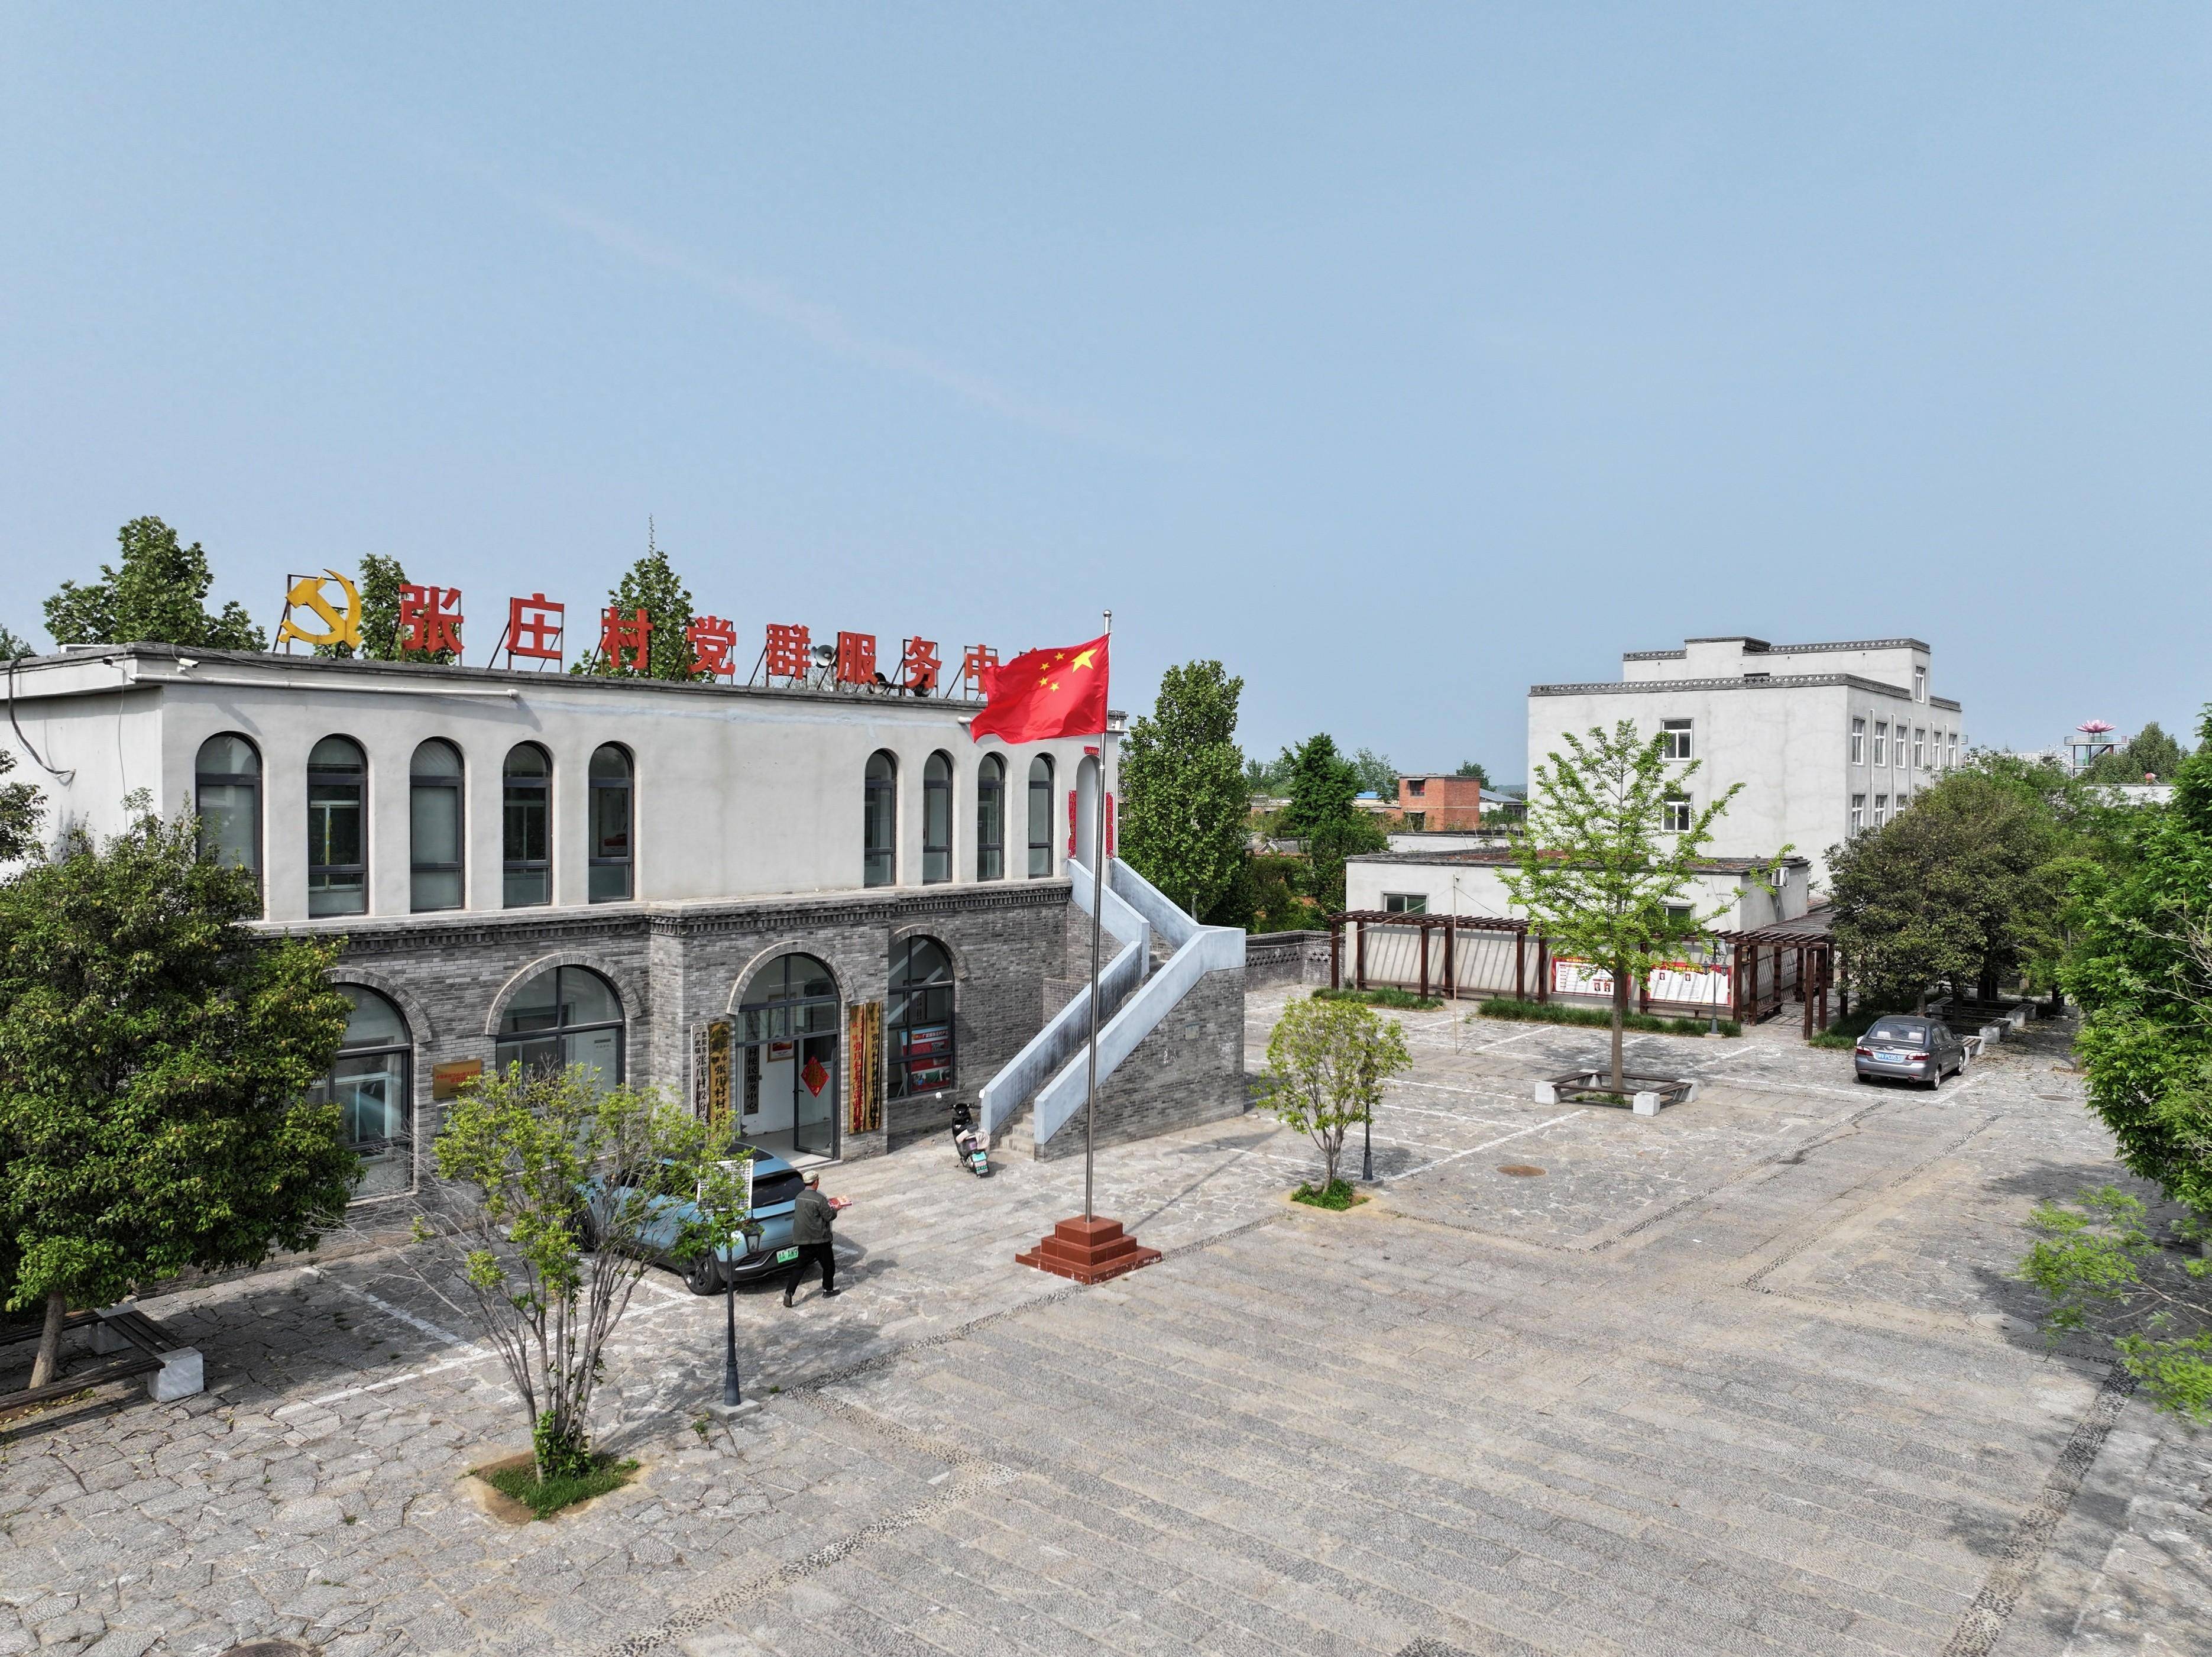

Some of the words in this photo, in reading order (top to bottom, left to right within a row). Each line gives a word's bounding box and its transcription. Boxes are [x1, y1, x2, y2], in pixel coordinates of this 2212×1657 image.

[399, 583, 1038, 694] 张庄村党群服务中
